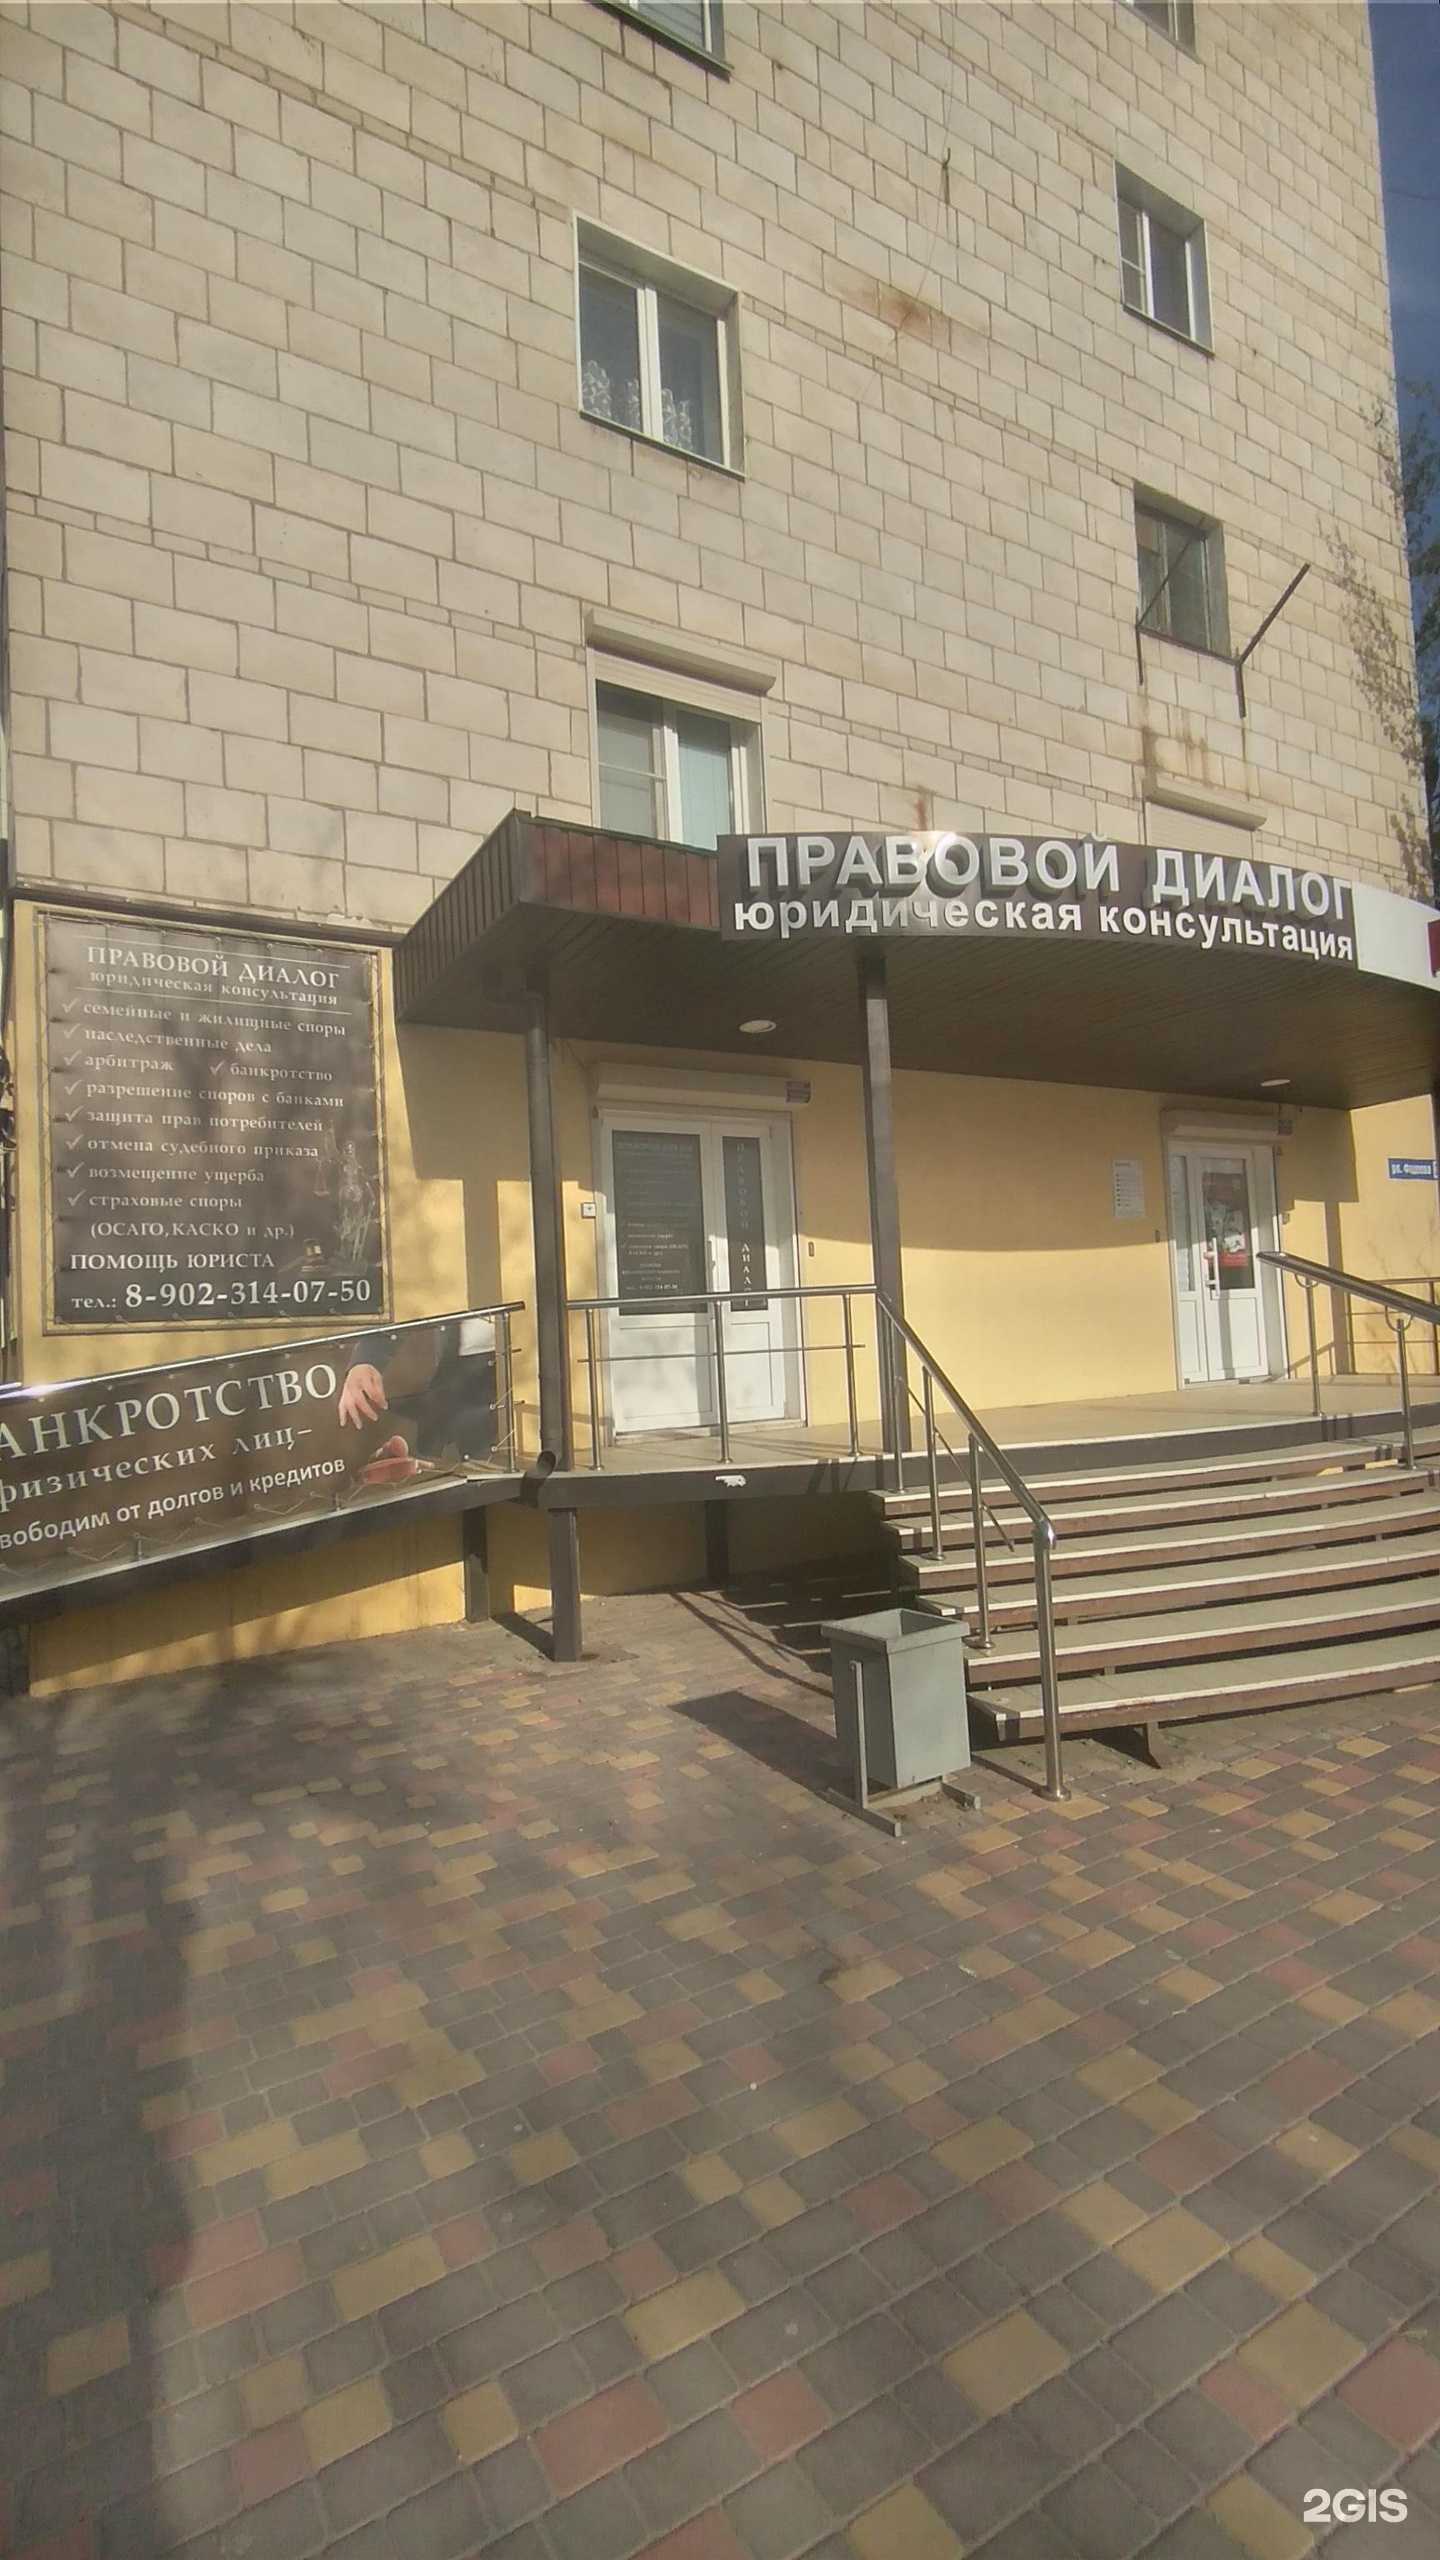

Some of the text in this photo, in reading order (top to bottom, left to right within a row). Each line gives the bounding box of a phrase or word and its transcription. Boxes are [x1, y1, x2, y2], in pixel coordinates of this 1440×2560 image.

[747, 833, 1352, 920] ПРАВОВОЙ ДИАЛОГ
[735, 899, 1353, 960] юридическая консультация
[87, 946, 340, 989] ПРАВОВОЙ ДИАЛОГ
[90, 971, 338, 1007] юридическая консультация
[83, 1002, 346, 1038] семейные и жилищные споры
[84, 1028, 272, 1054] наследственные дела
[84, 1054, 174, 1073] арбитраж
[230, 1062, 333, 1081] банкротство
[86, 1083, 344, 1107] разрешение споров с банками
[87, 1110, 323, 1132] защита прав потребителей
[87, 1139, 319, 1159] отмена судебного приказа
[88, 1167, 265, 1185] возмещение ущерба
[88, 1195, 242, 1212] страховые споры
[247, 1226, 256, 1237] и
[263, 1224, 295, 1239] др.)
[71, 1252, 275, 1274] ПОМОЩЬ ЮРИСТА
[71, 1278, 371, 1309] тел.: 8-902-314-07-50
[116, 1504, 141, 1522] от
[148, 1485, 225, 1520] долгов
[229, 1482, 244, 1497] и
[249, 1458, 346, 1494] кредитов
